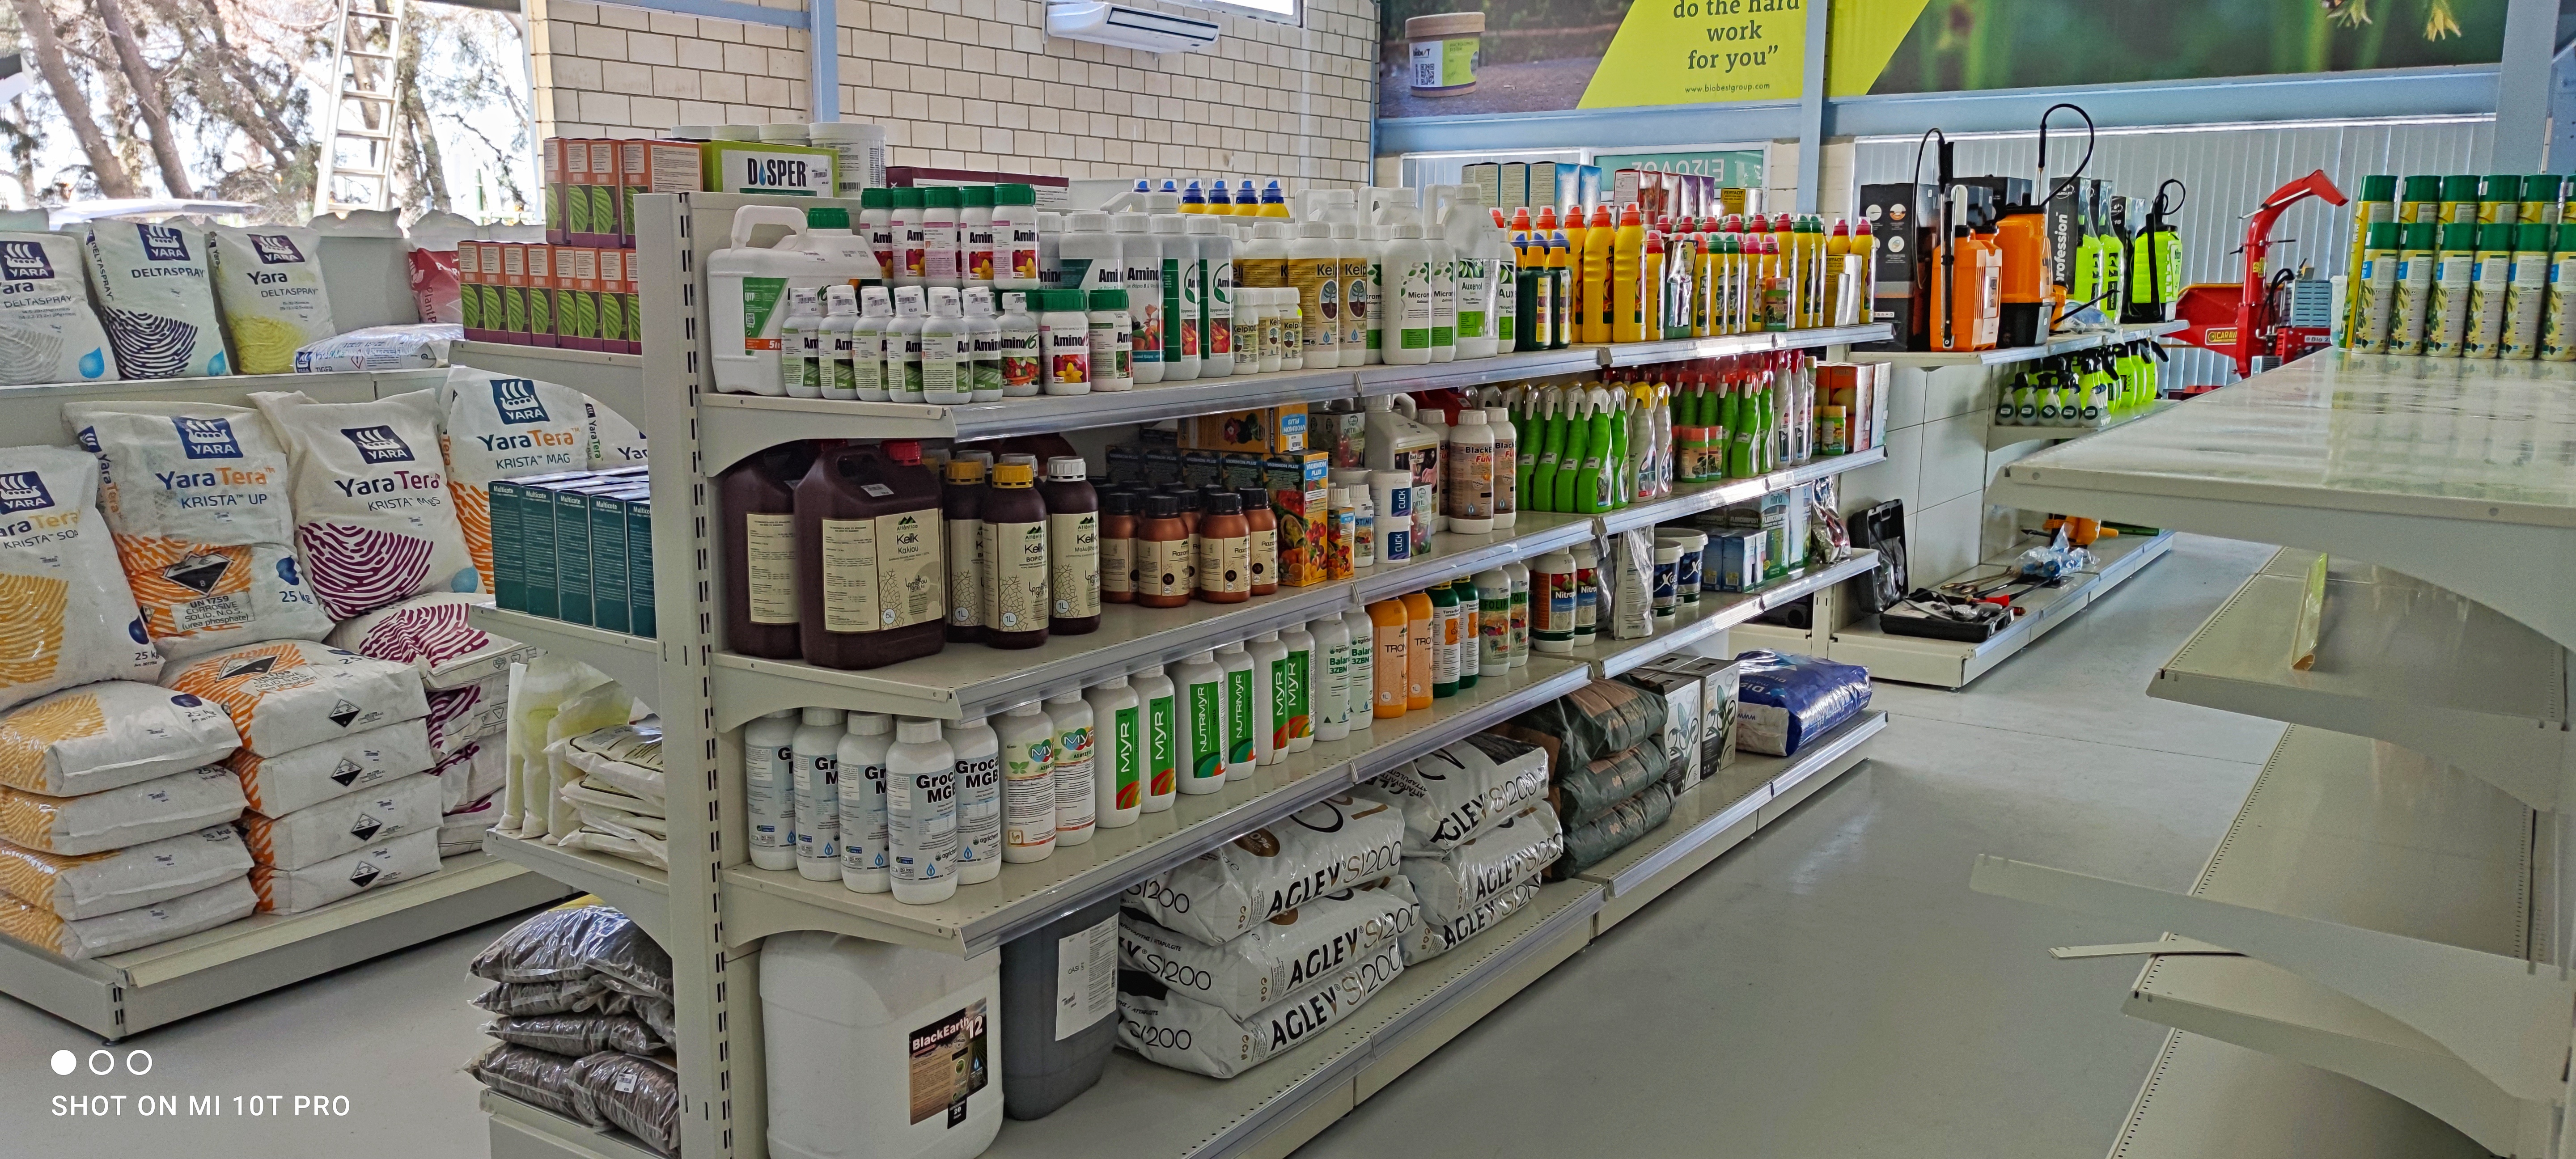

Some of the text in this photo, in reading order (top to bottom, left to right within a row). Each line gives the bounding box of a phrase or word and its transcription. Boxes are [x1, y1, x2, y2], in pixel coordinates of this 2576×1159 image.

[1674, 0, 1698, 18] do
[1707, 0, 1740, 16] the
[1707, 20, 1762, 42] work
[1688, 50, 1719, 69] for
[1685, 83, 1770, 93] www.biobestgroup.com
[151, 248, 185, 257] YARA
[263, 253, 299, 261] YARA
[8, 268, 48, 277] YARA
[131, 267, 205, 279] DELTASPRAY
[246, 270, 288, 285] Yara
[1462, 282, 1482, 290] Auxenol
[4, 295, 72, 309] DELTASPRAY
[506, 408, 545, 420] YARA
[191, 444, 236, 454] YARA
[368, 449, 408, 460] YARA
[547, 453, 570, 465] MAG
[493, 485, 514, 494] Multicote
[526, 490, 546, 499] Multicote
[3, 498, 47, 508] YARA
[248, 493, 267, 505] UP
[560, 495, 581, 504] Multicote
[596, 500, 617, 510] Multicote
[897, 533, 919, 545] Kelik
[898, 546, 919, 555] Καλίου
[190, 596, 229, 608] UN 1759
[279, 591, 311, 604] 25 kg
[186, 601, 237, 614] CORROSIVE
[216, 609, 242, 617] N.O.S.
[182, 613, 249, 630] (urea phosphate)
[135, 651, 148, 660] 25
[965, 771, 998, 789] MGB
[980, 833, 998, 843] agrichem
[913, 1015, 983, 1051] BlackEarth 12
[954, 1106, 961, 1115] 20
